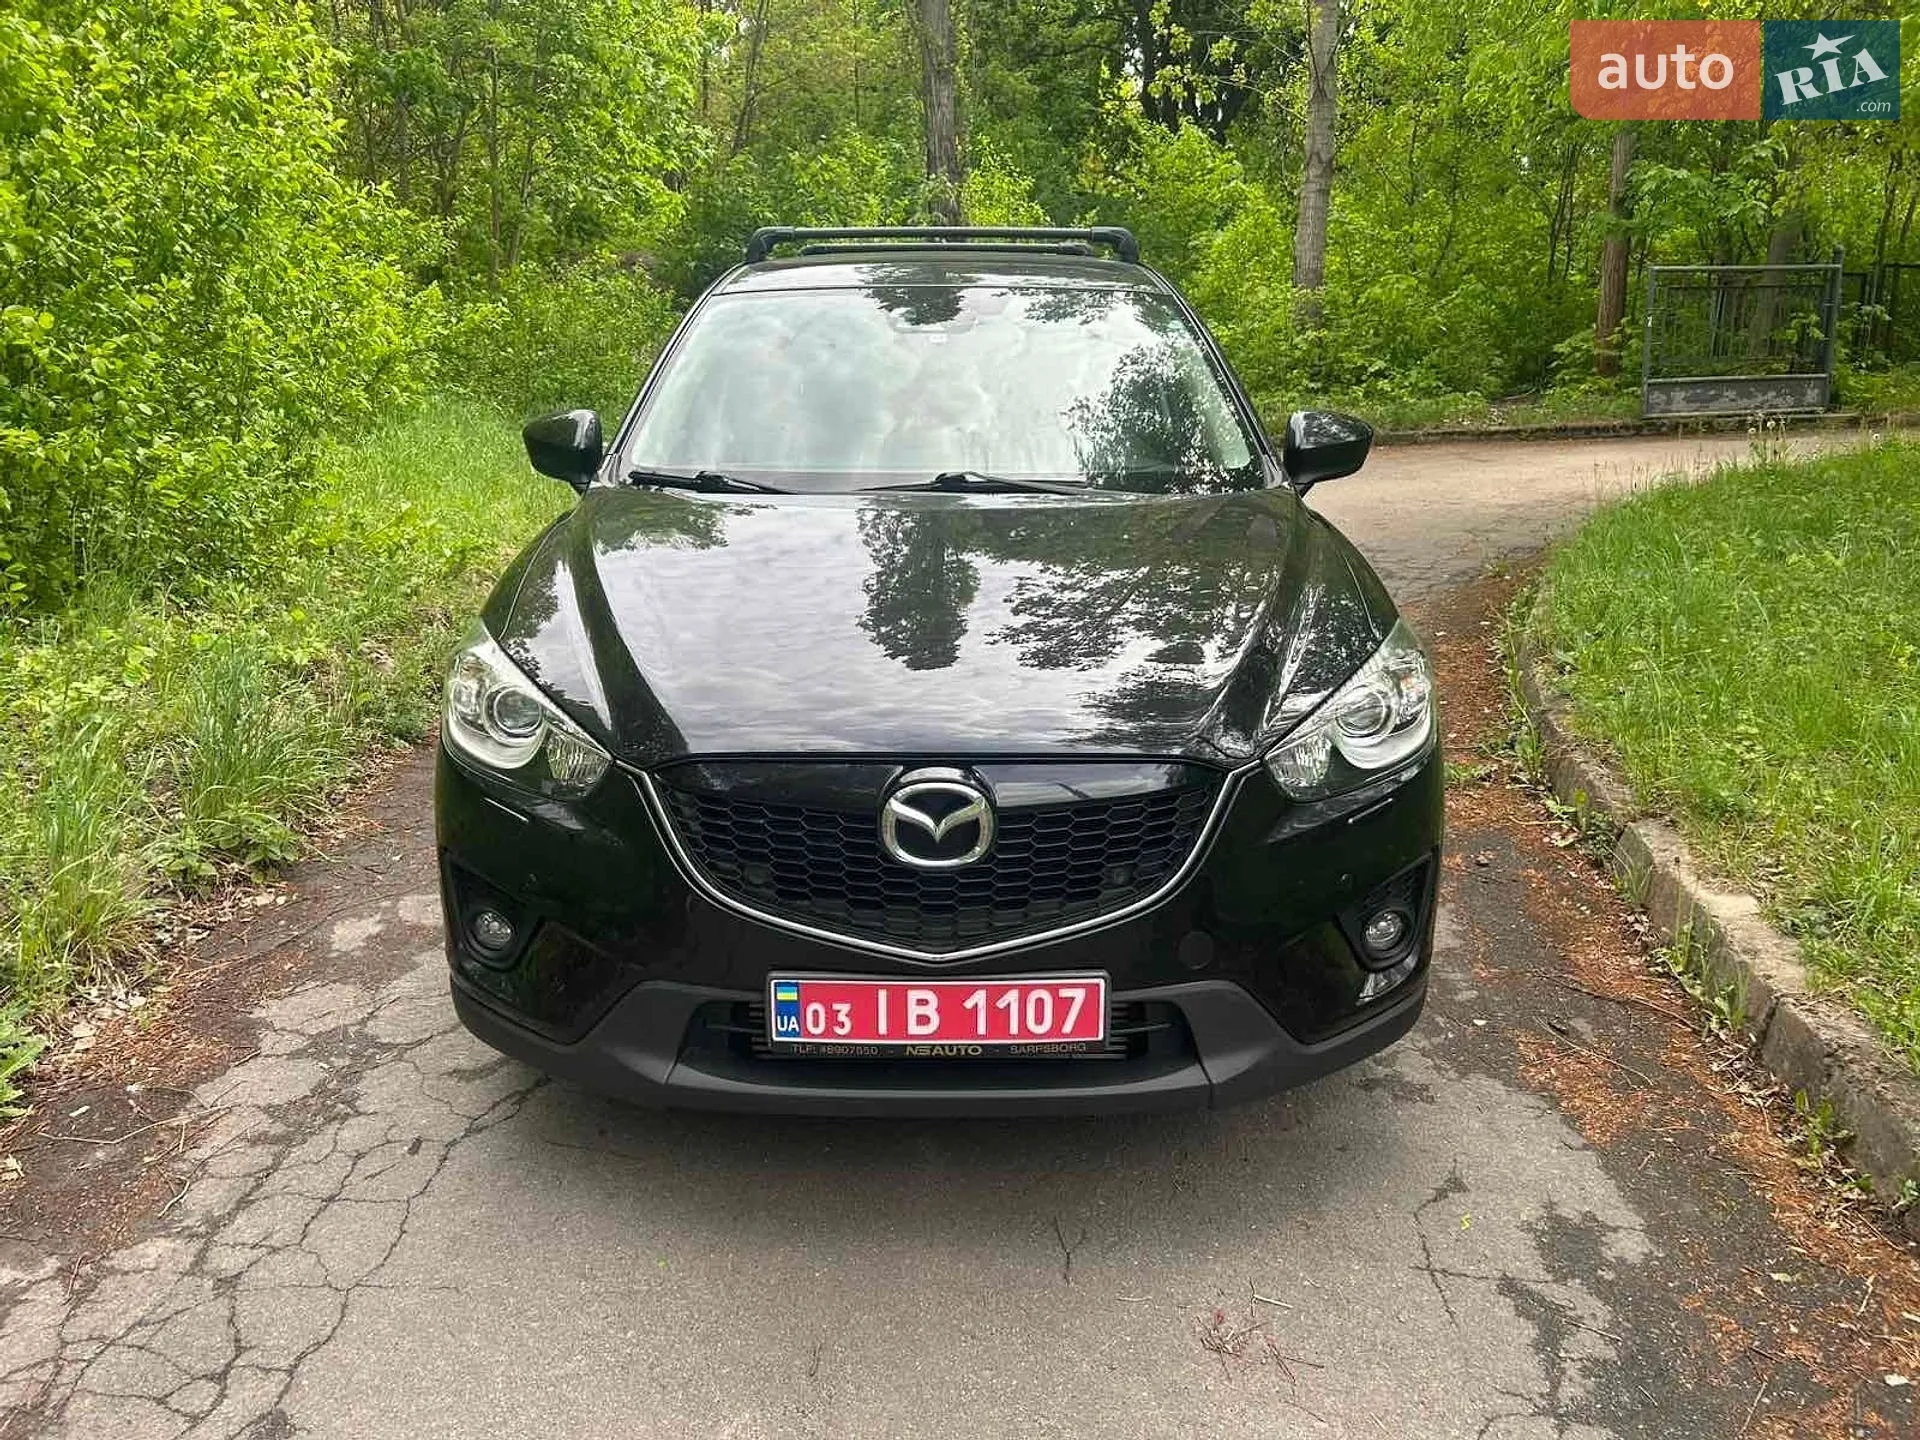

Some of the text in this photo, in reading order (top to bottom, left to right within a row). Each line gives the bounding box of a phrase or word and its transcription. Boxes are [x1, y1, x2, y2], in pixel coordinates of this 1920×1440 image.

[776, 1013, 800, 1033] UA
[804, 987, 1087, 1036] 03 IB 1107
